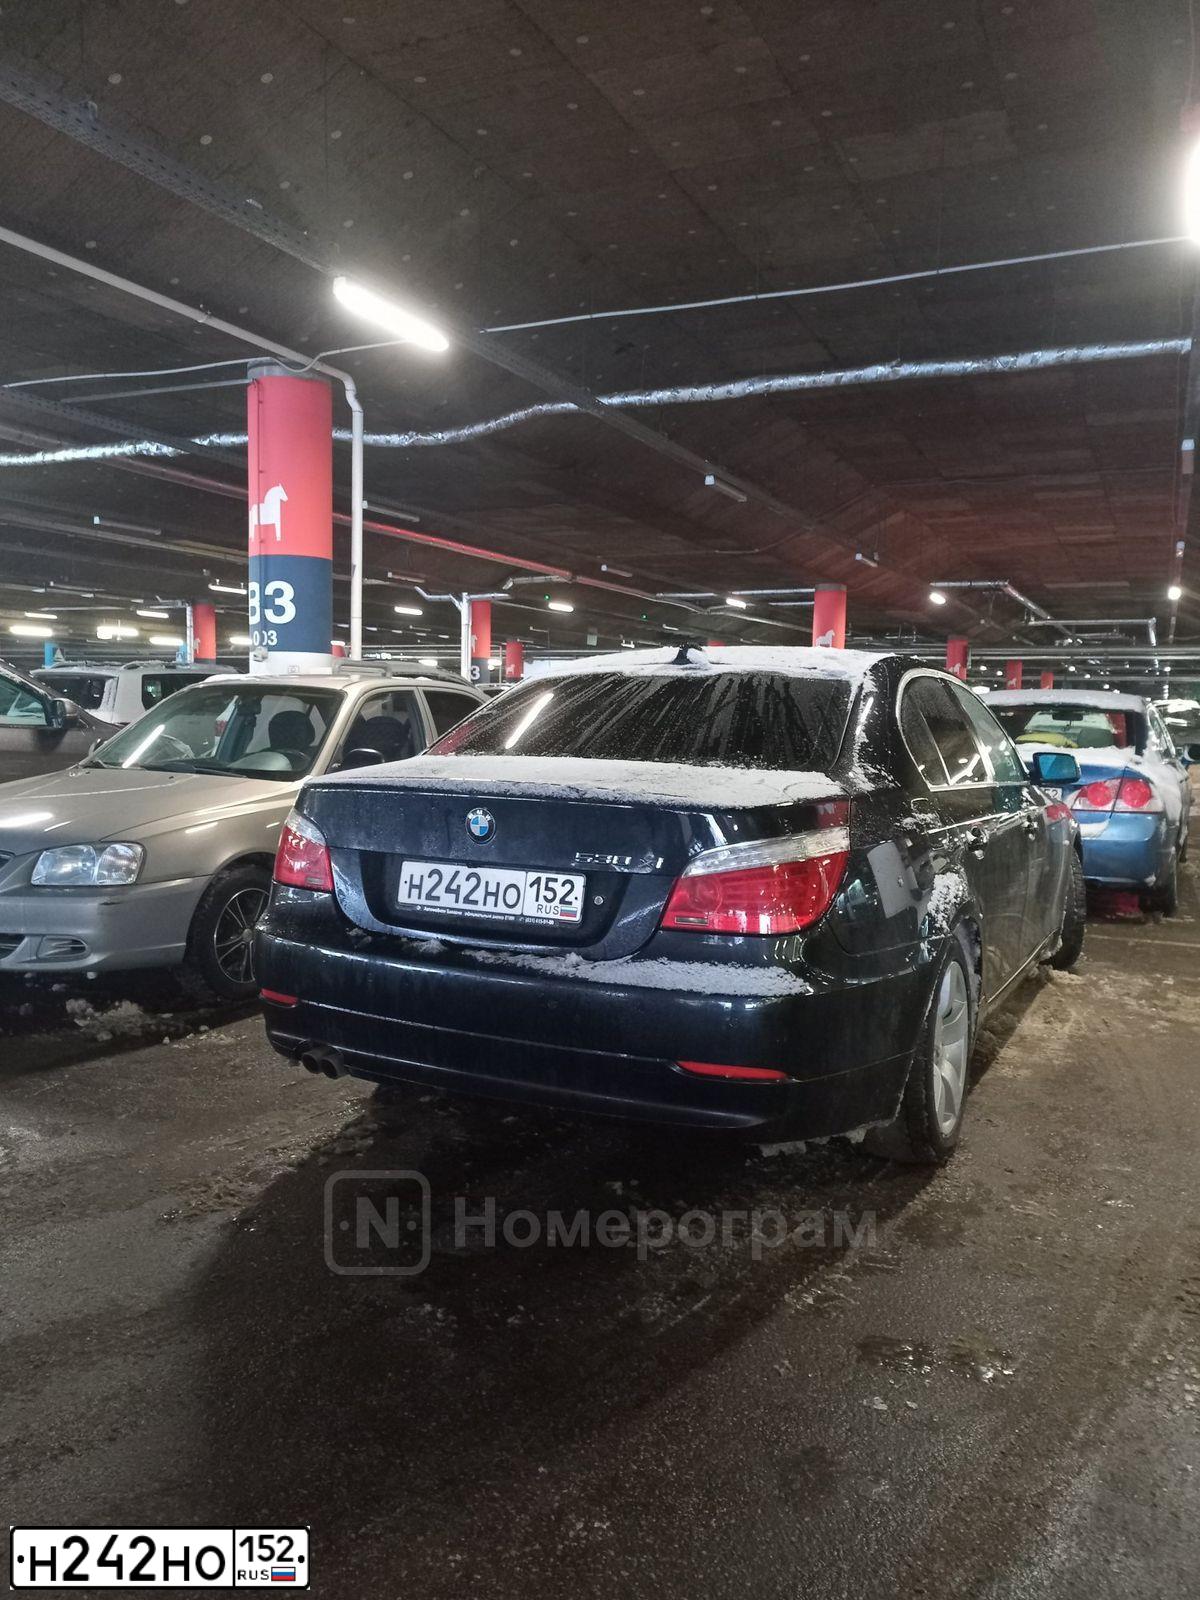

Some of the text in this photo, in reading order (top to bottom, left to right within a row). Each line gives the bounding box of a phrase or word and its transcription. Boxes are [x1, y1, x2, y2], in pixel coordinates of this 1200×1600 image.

[407, 868, 576, 909] Н242НО 152
[536, 903, 560, 916] RUS
